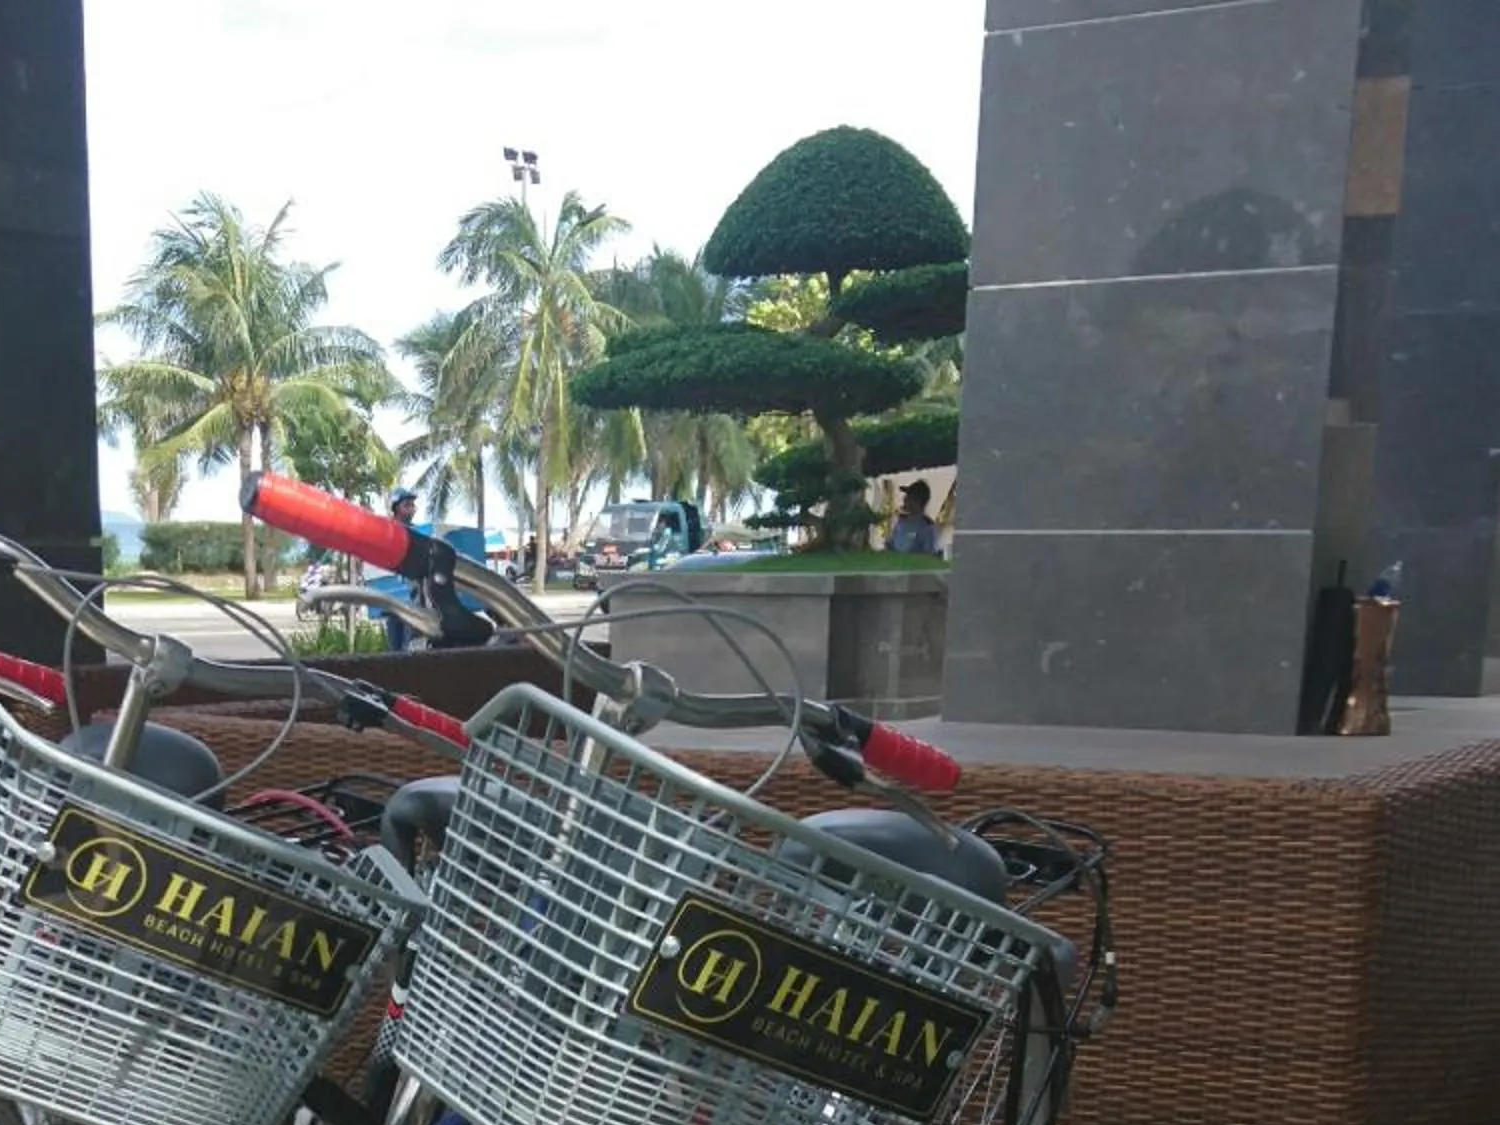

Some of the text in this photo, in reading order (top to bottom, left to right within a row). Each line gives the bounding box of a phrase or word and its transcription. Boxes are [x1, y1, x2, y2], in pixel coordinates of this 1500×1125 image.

[79, 853, 133, 902] H
[143, 915, 203, 949] BEACH
[209, 939, 265, 971] HOTEL
[154, 871, 345, 973] HAIAN
[690, 948, 747, 1003] H
[766, 963, 953, 1069] HAIAN
[750, 1016, 809, 1049] BEACH
[816, 1041, 868, 1072] HOTEL
[890, 1068, 924, 1090] SPA
